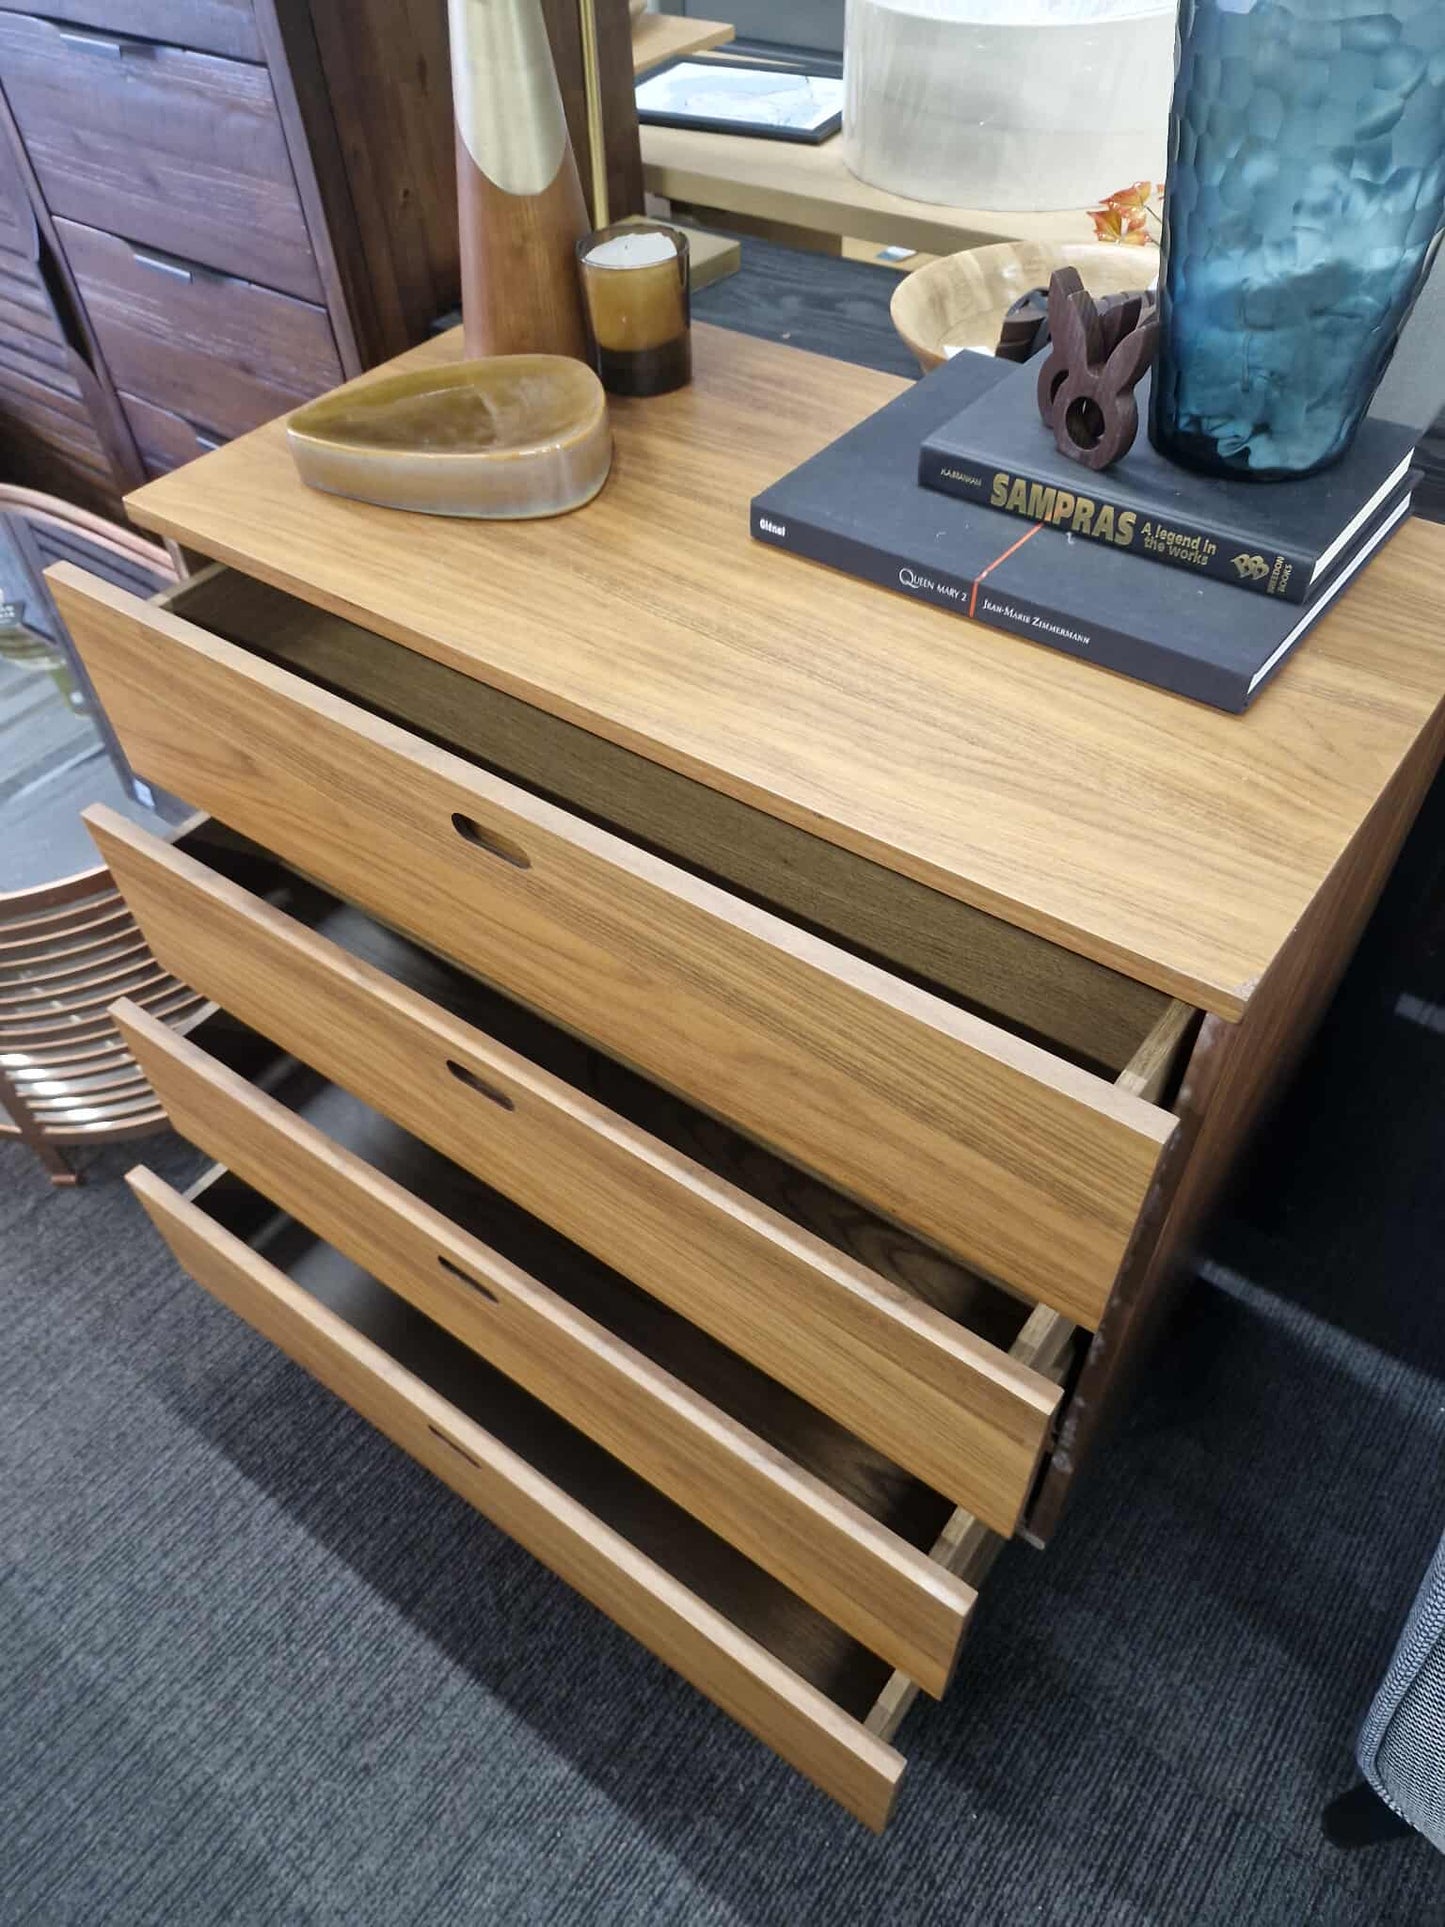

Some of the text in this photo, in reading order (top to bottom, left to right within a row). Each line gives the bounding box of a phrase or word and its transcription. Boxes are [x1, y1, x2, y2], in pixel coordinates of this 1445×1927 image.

[990, 472, 1138, 546] SAMPRAS
[1140, 521, 1217, 556] A legend in
[1144, 535, 1209, 566] the works
[899, 567, 969, 602] QUEEN MARY 2
[982, 598, 1091, 645] JEAN-MARIE ZIMMERMANN
